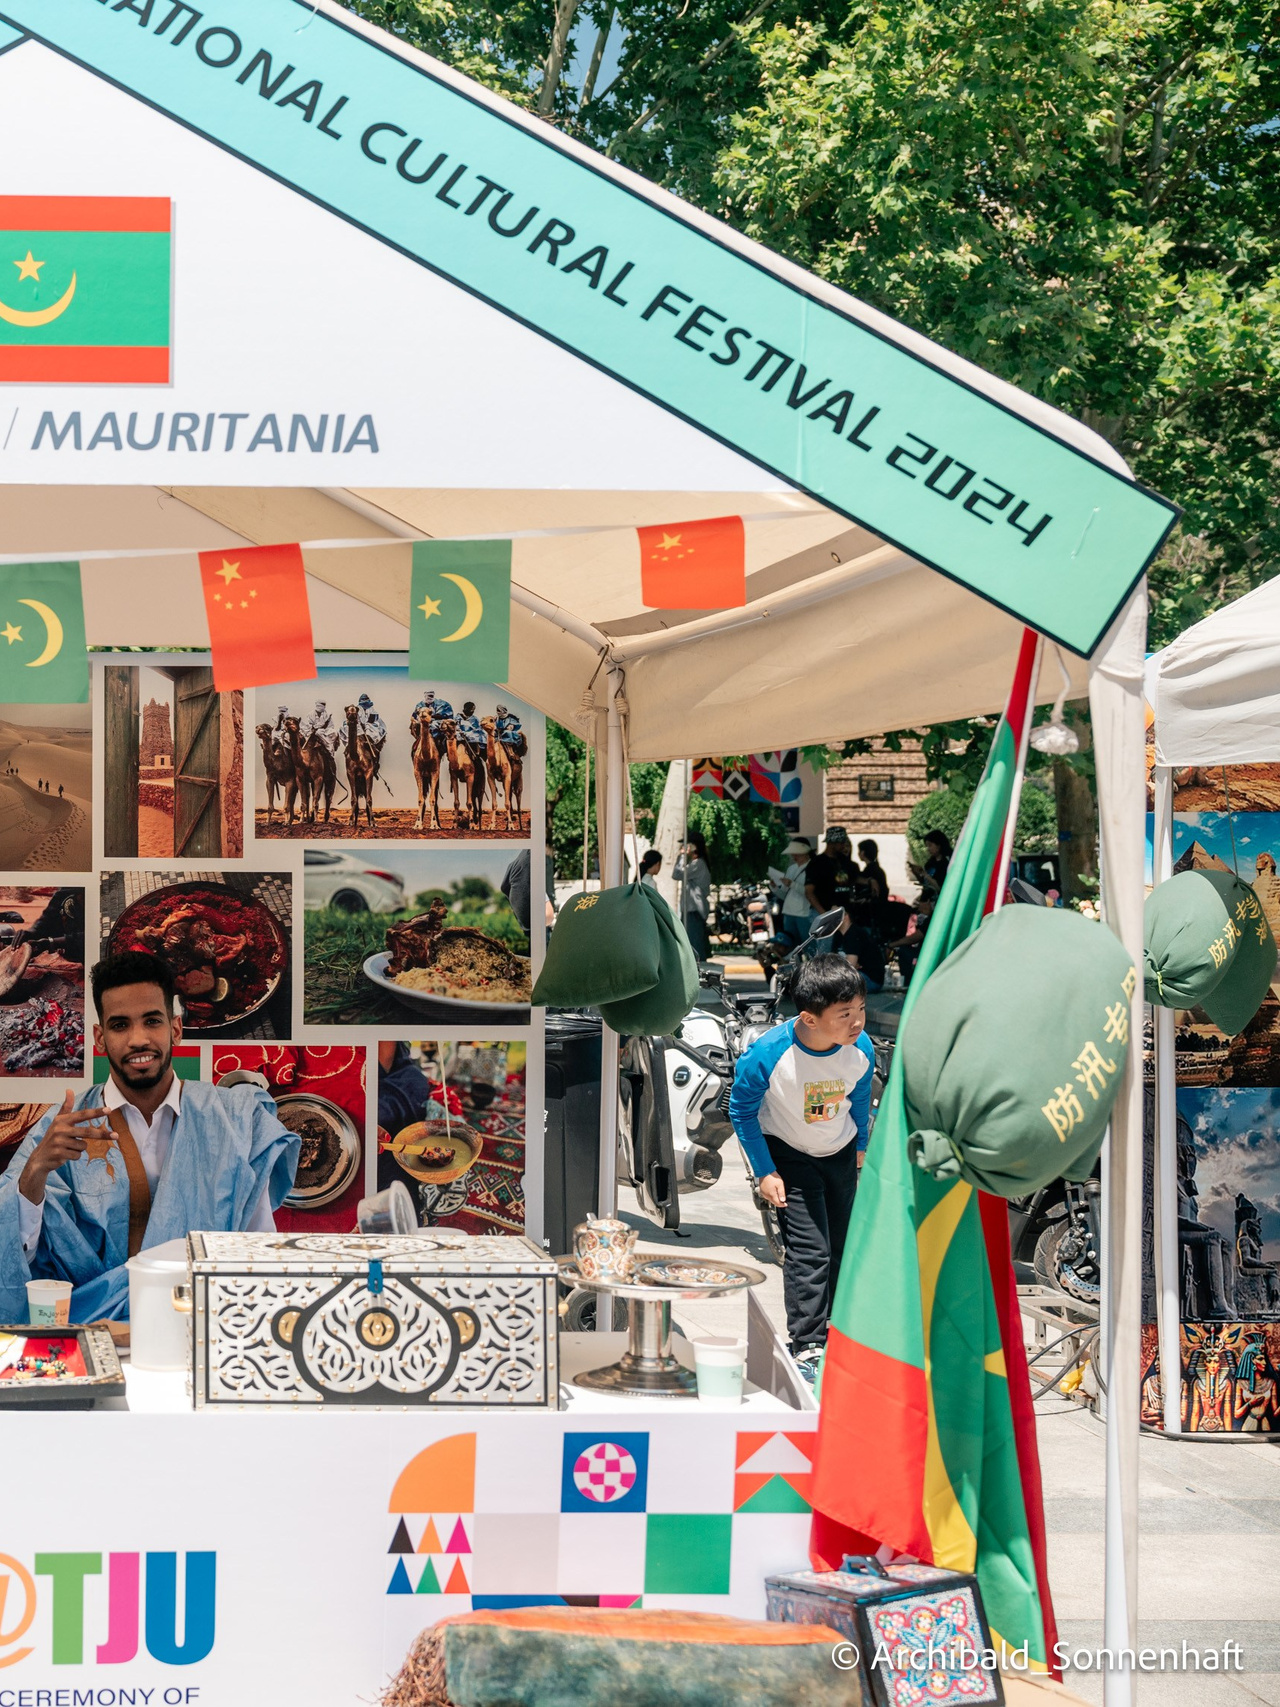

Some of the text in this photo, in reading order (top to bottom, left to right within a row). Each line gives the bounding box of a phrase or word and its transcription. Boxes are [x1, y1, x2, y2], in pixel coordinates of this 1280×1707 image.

[94, 0, 1053, 547] ATIONAL CULTURAL FESTIVAL 2024
[30, 410, 380, 454] MAURITANIA
[163, 1686, 200, 1705] OF
